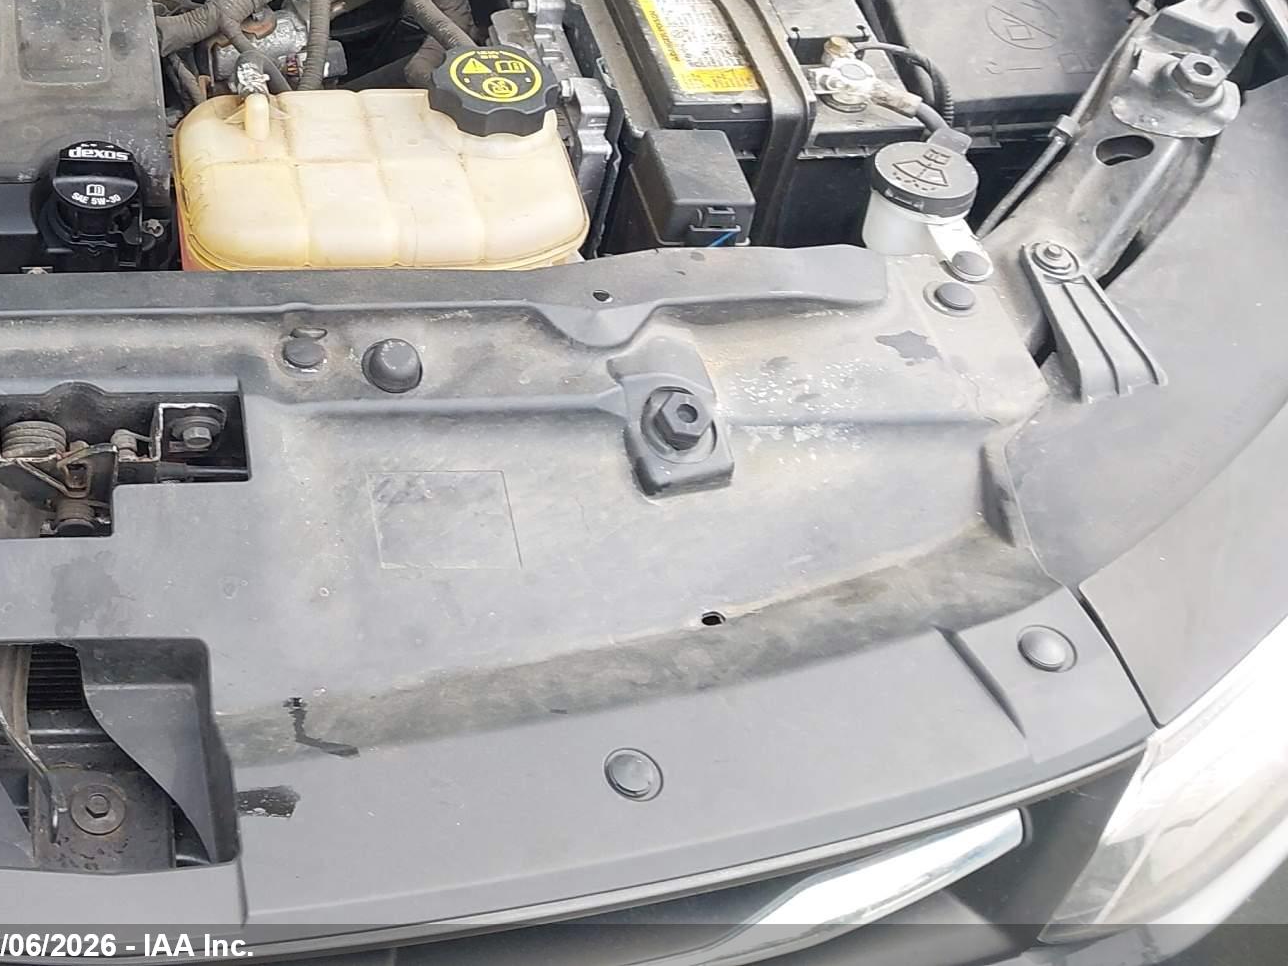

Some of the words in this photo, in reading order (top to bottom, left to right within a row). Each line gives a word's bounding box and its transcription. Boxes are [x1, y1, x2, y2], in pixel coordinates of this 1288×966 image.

[68, 146, 130, 161] dexos
[71, 192, 90, 204] SAE
[91, 194, 122, 205] 5W-30
